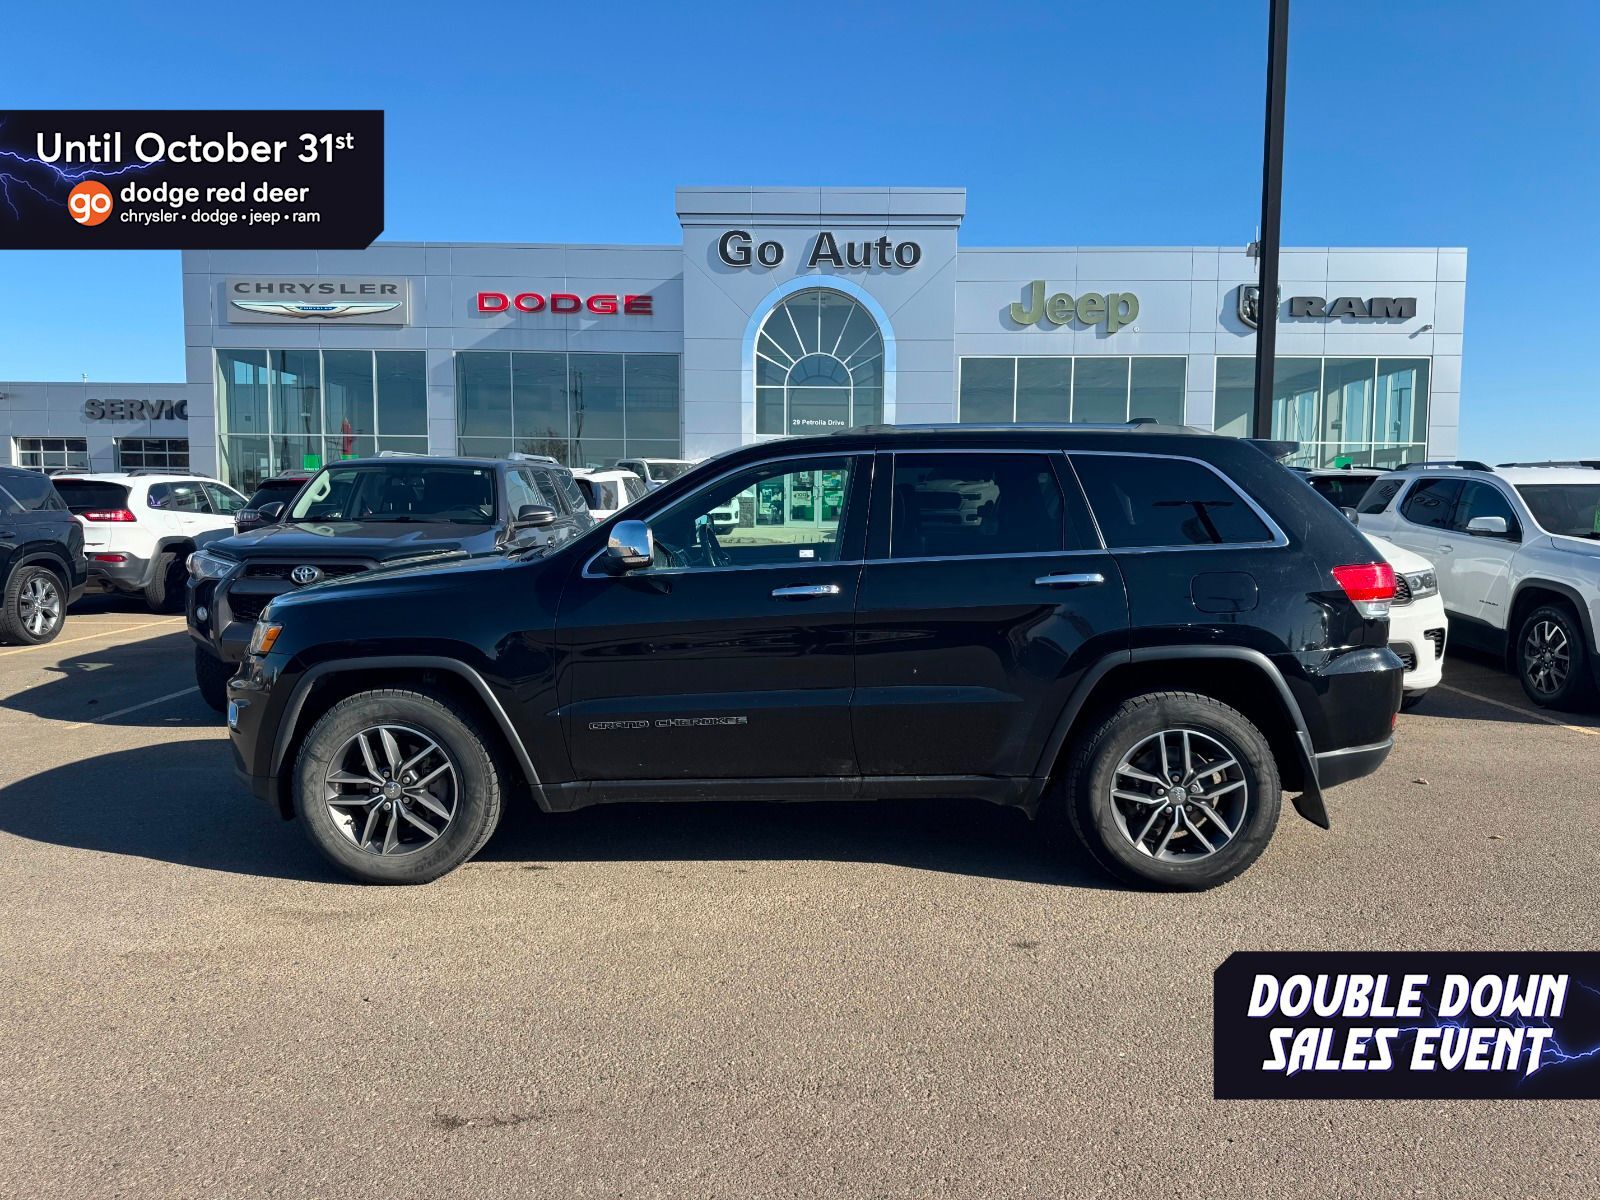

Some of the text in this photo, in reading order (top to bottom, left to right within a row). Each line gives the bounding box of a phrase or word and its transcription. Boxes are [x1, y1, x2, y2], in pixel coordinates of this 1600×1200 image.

[717, 229, 922, 269] Go Auto
[233, 282, 398, 295] CHRYSLER
[477, 292, 653, 316] DODGE
[1010, 280, 1139, 333] Jeep
[1291, 297, 1417, 318] RAM
[589, 716, 748, 730] GRAND CHEROKEE
